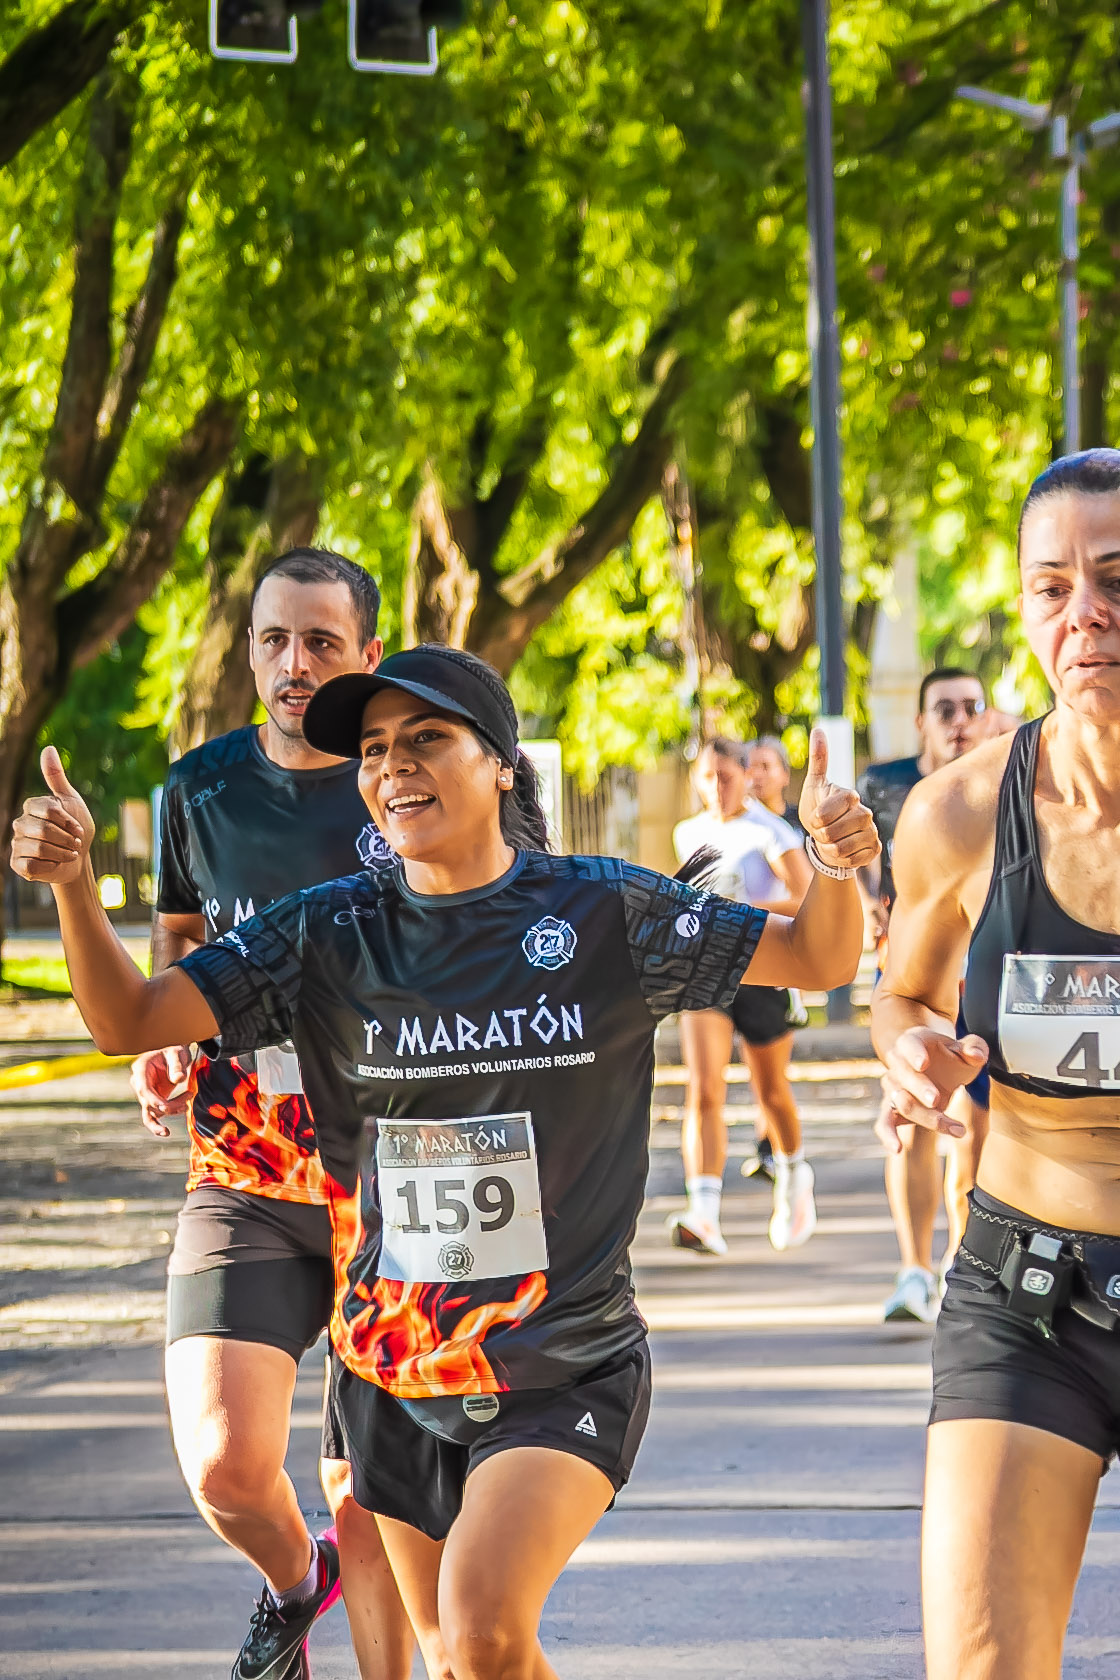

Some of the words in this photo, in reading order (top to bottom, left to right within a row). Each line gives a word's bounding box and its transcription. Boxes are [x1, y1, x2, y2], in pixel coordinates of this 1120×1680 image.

[396, 993, 584, 1057] MARATÓN
[405, 1063, 471, 1080] BOMBEROS
[471, 1056, 552, 1075] VOLUNTARIOS
[553, 1051, 597, 1068] ROSARIO
[414, 1124, 508, 1154] MARATÓN
[396, 1175, 516, 1235] 159
